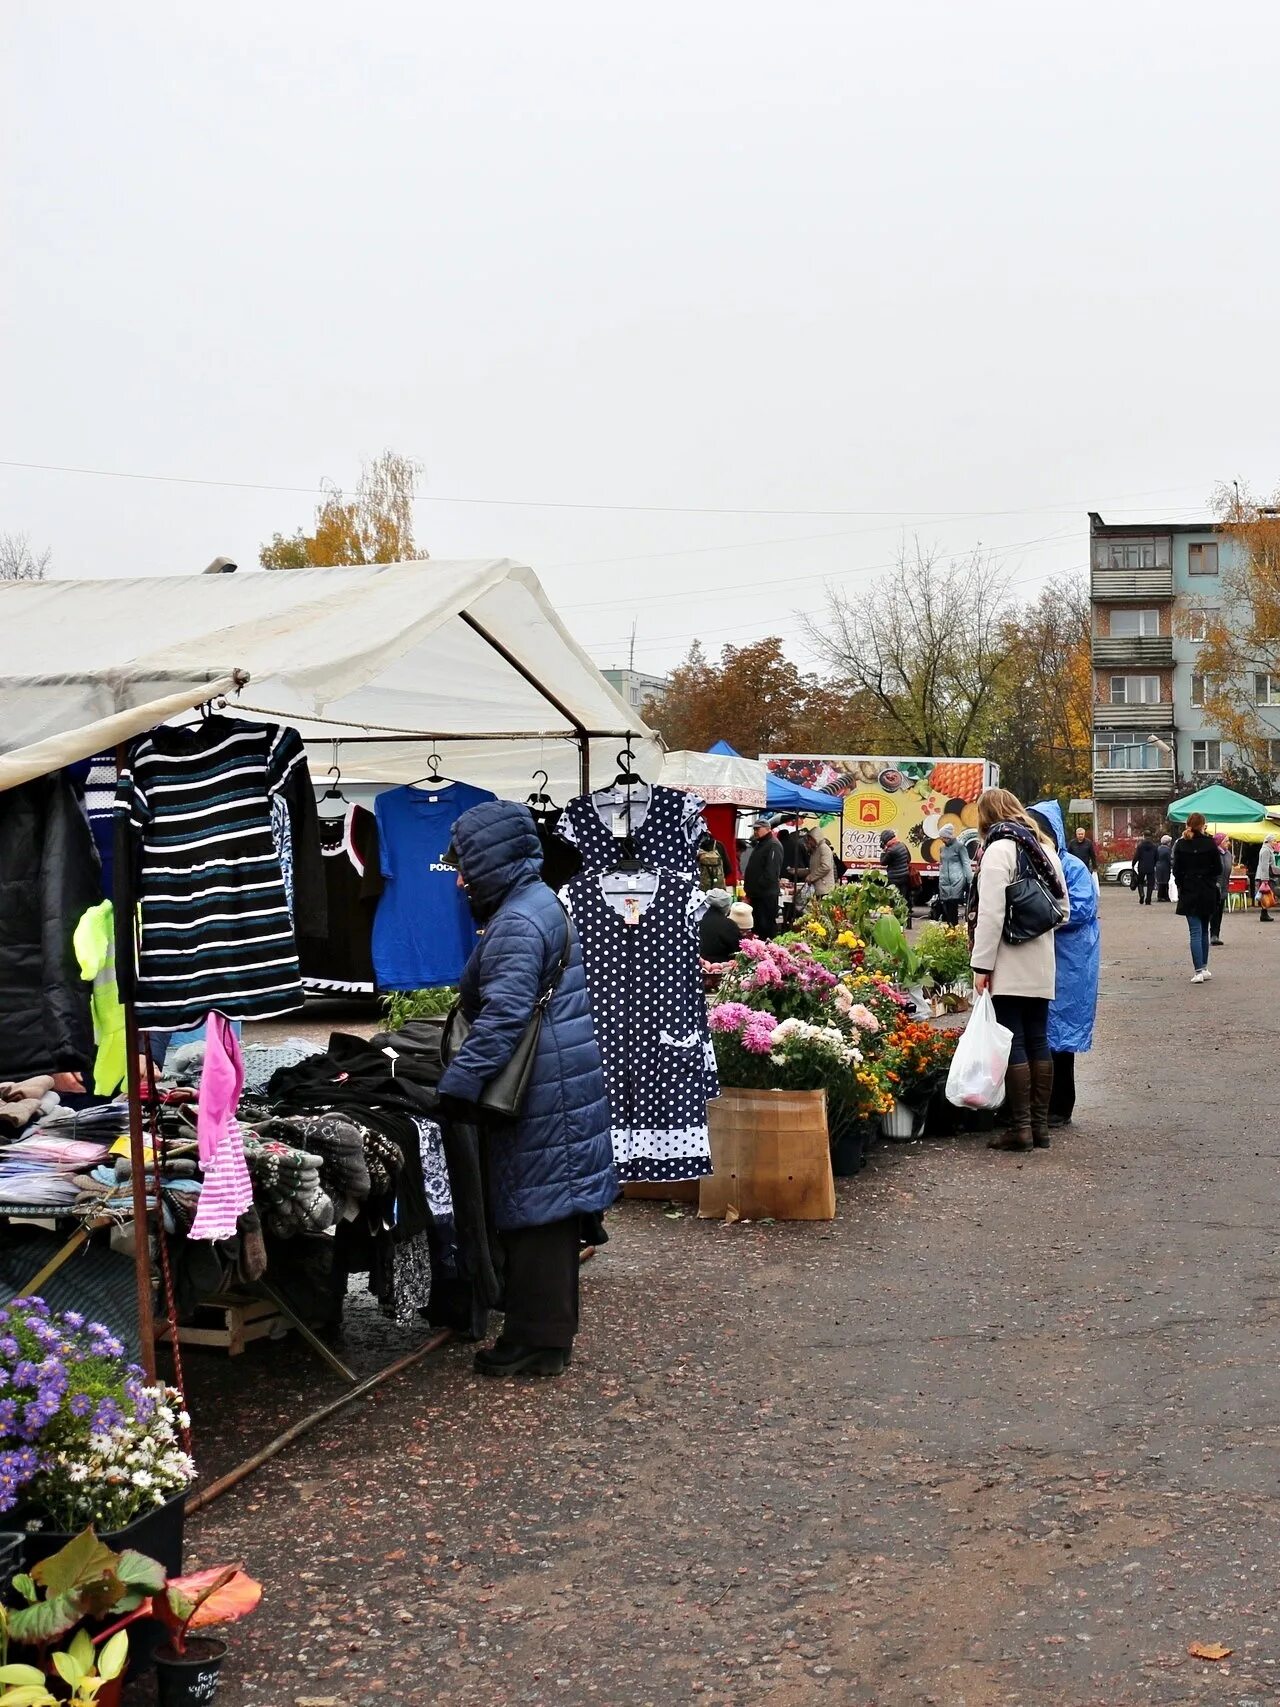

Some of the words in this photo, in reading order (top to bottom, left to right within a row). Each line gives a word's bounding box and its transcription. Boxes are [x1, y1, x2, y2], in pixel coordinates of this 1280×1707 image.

[842, 830, 881, 844] Свеж
[844, 844, 881, 859] ХЛЕ
[429, 863, 457, 872] РОСС
